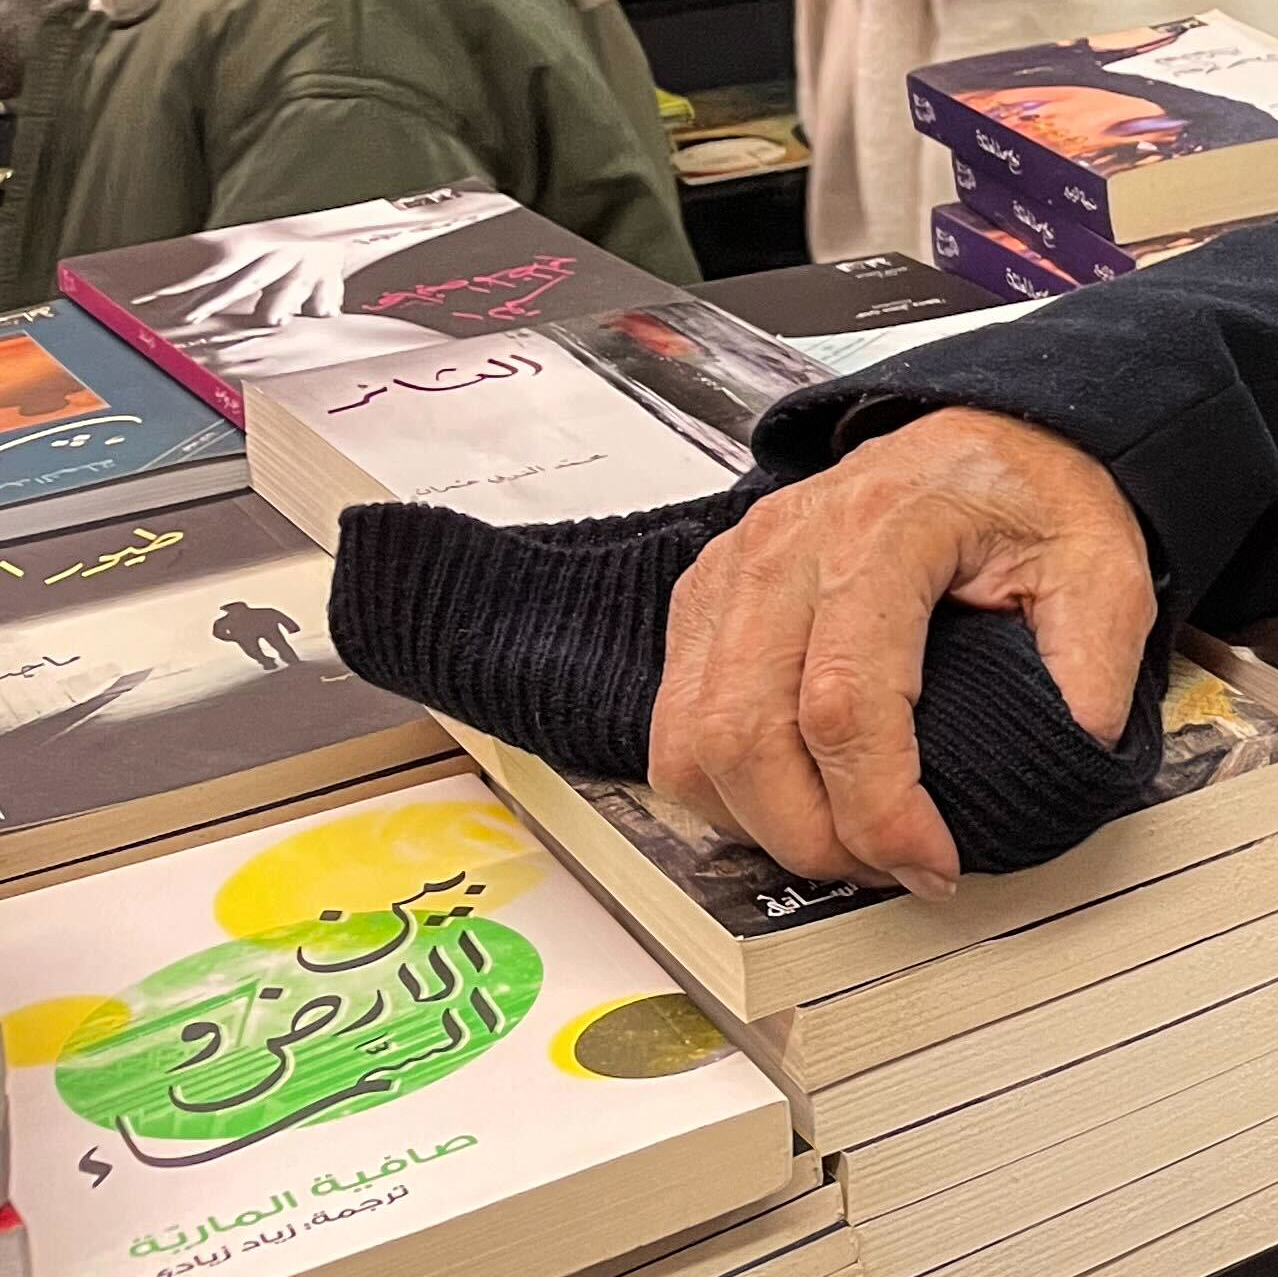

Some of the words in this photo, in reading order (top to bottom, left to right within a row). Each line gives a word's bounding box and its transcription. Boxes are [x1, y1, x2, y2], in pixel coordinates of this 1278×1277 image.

[44, 527, 184, 585] طيور
[298, 870, 487, 974] بين
[309, 1133, 479, 1197] صافية
[241, 1223, 297, 1253] زياد
